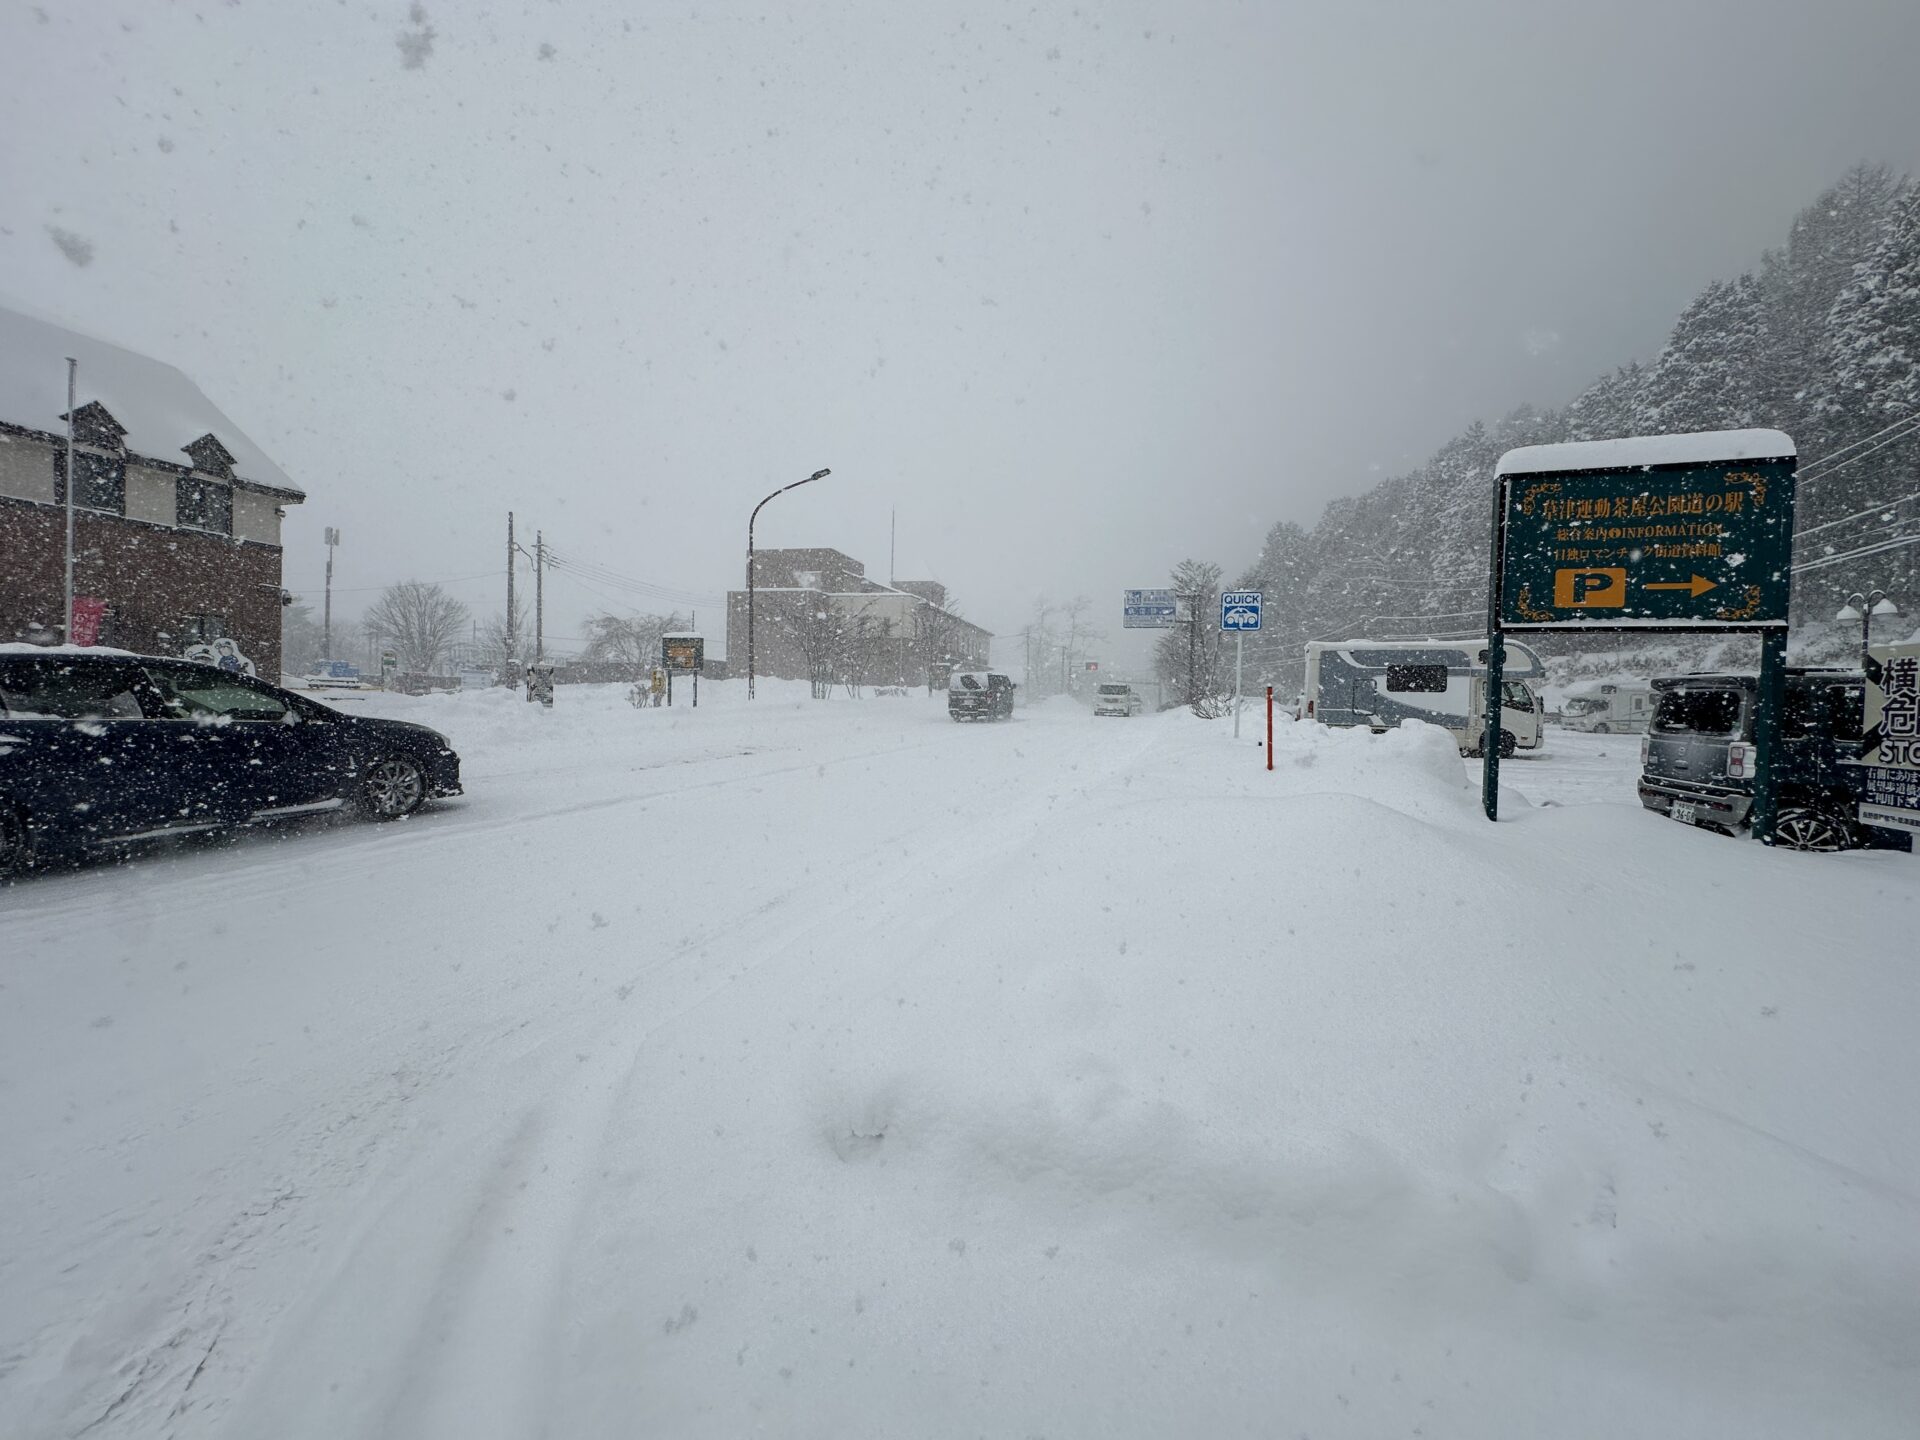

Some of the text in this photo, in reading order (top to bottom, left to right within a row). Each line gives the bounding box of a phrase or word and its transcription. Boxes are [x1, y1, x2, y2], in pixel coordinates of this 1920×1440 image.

[1543, 491, 1744, 520] 草津運動茶屋公園道の駅
[1554, 542, 1721, 561] 日独ロマンチク街道資料館
[1224, 595, 1259, 604] QUICK
[1573, 573, 1613, 602] P
[1879, 697, 1920, 736] 危
